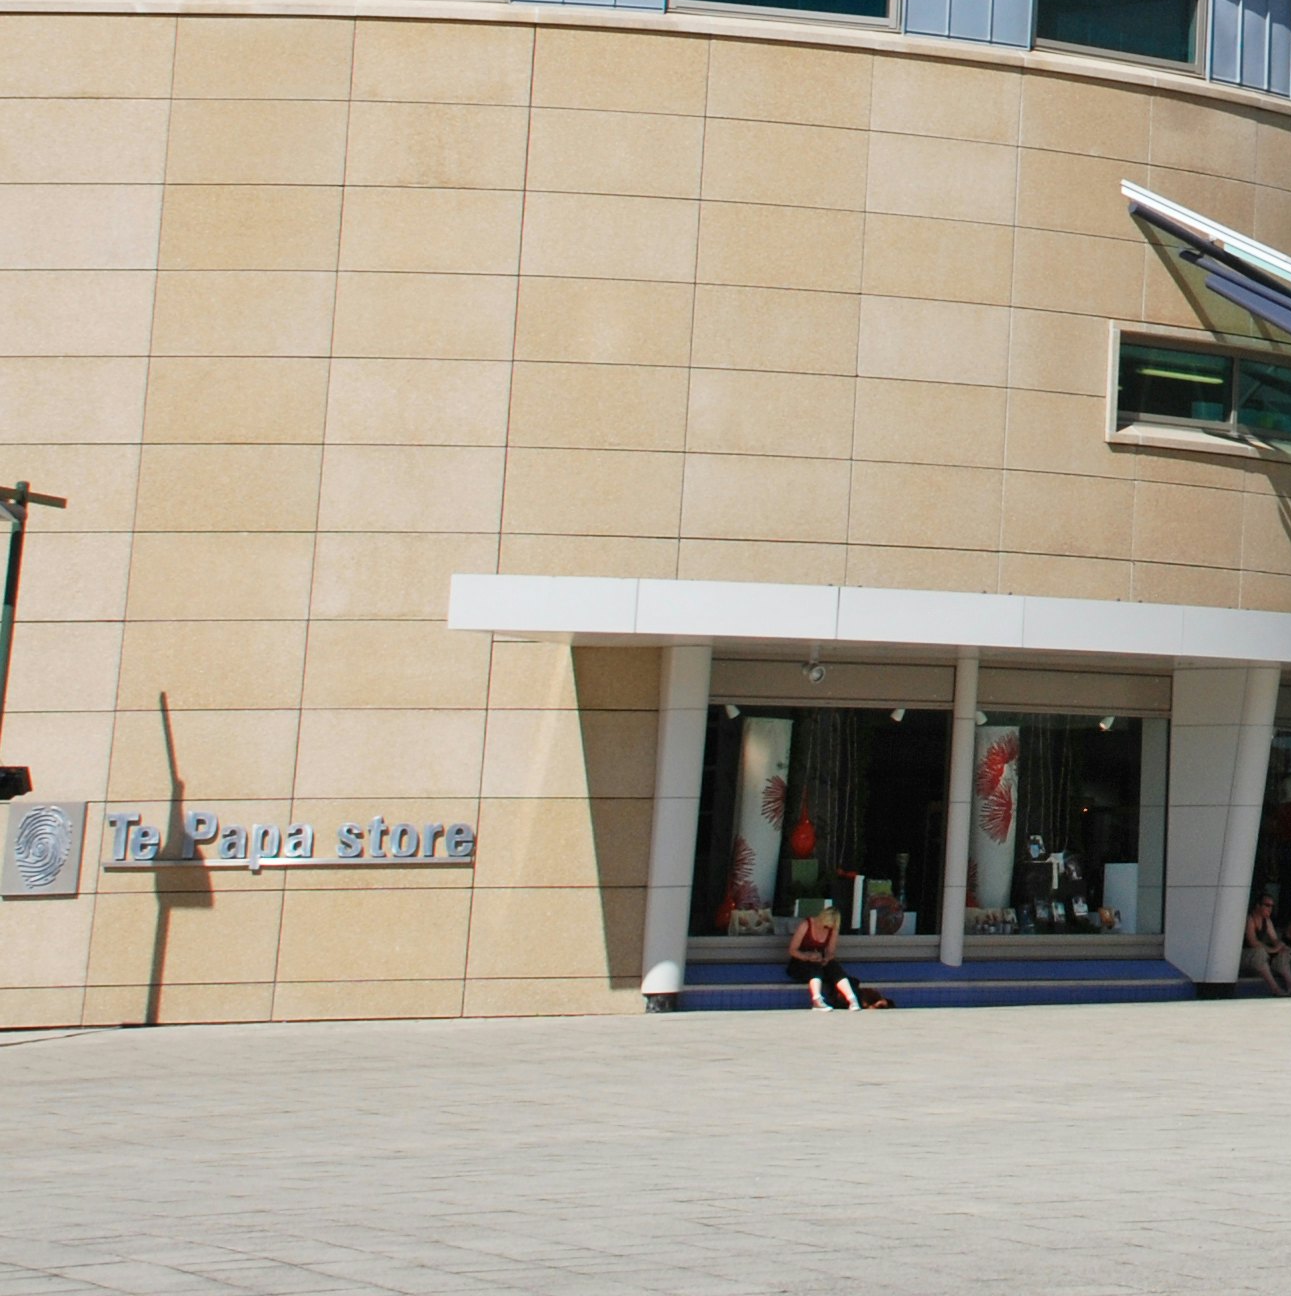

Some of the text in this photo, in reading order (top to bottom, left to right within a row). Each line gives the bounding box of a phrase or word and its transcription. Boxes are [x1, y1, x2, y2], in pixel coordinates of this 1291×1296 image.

[108, 811, 477, 872] Te Papa store
